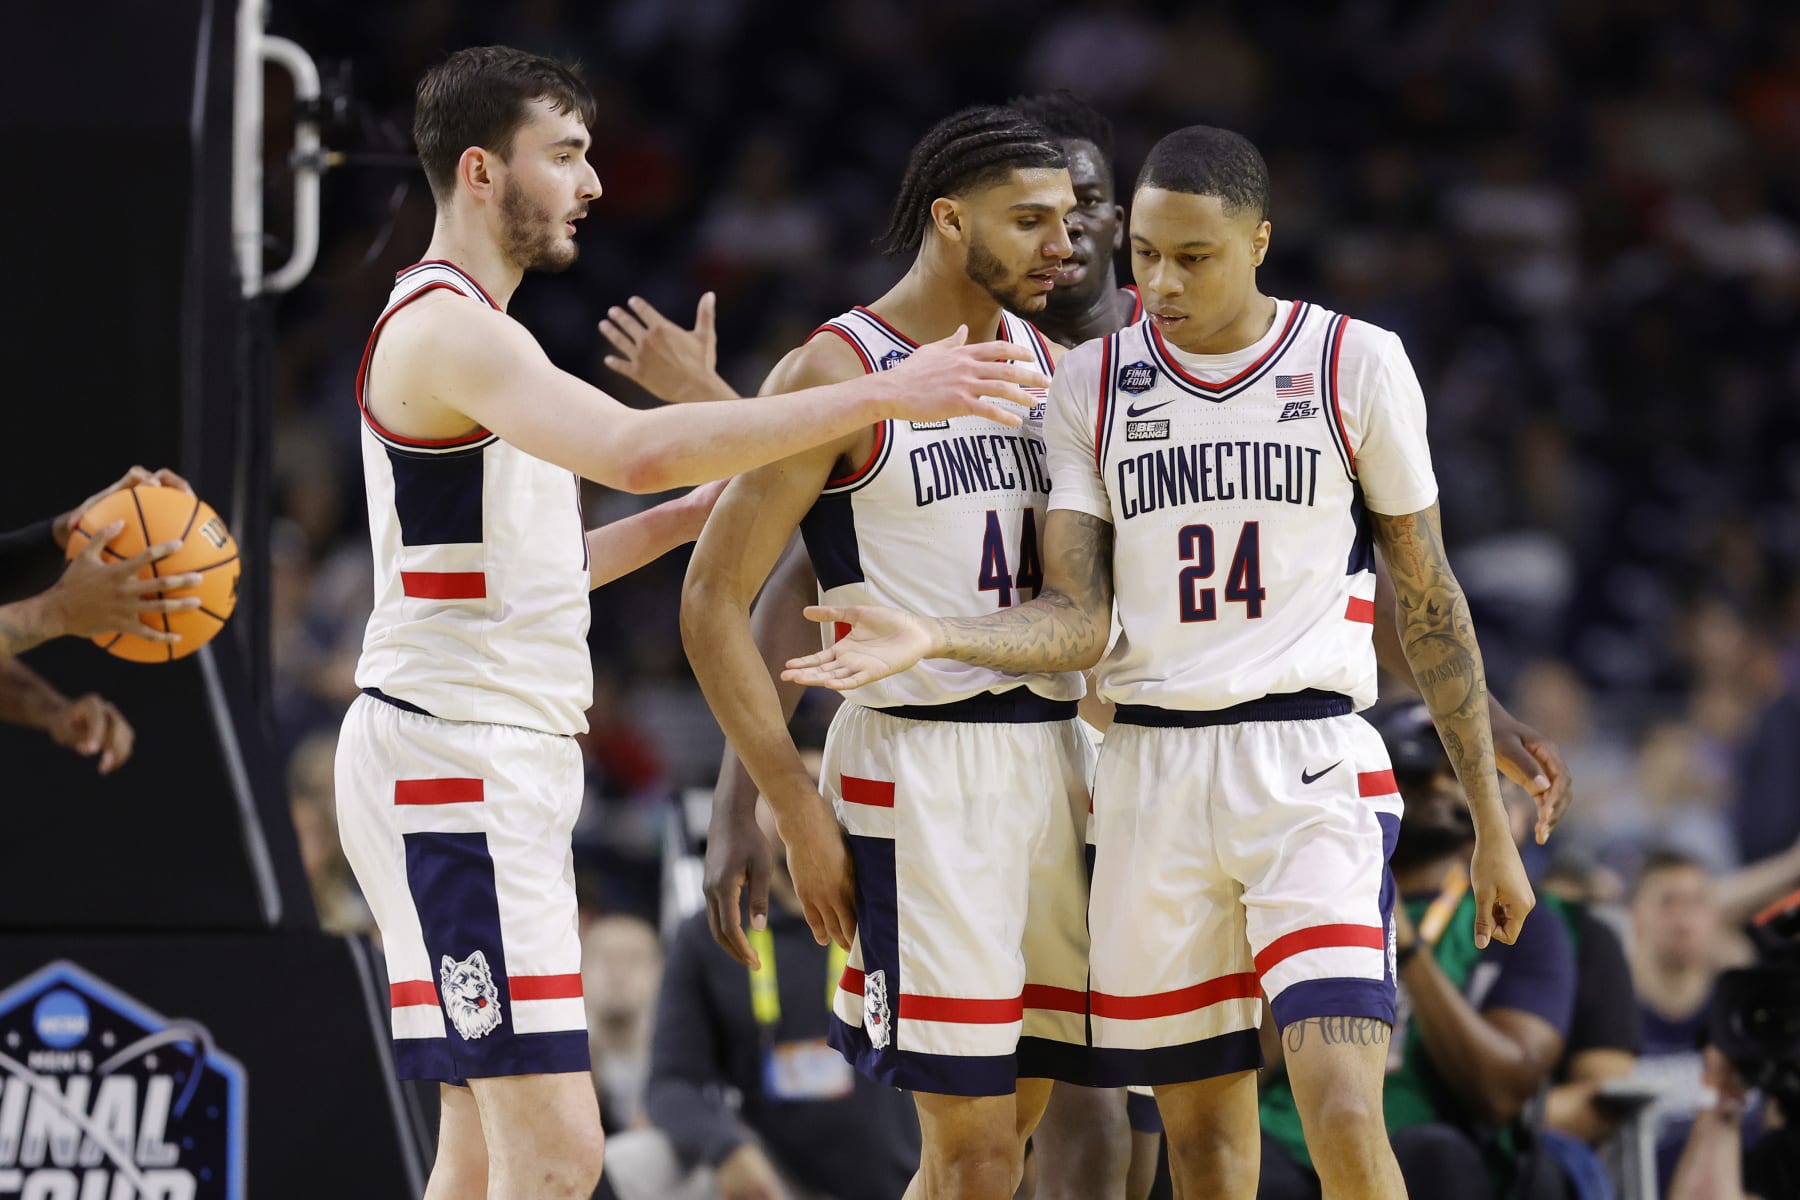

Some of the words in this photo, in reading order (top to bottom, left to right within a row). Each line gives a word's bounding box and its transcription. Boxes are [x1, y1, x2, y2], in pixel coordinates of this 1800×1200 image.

[1126, 369, 1151, 378] FINAL
[1126, 377, 1152, 386] FOUR
[1284, 400, 1311, 410] BIG
[1280, 408, 1320, 418] EAST
[912, 421, 948, 429] CHANGE
[1128, 430, 1168, 440] CHANGE
[909, 435, 1052, 507] CONNECTIC
[1118, 441, 1321, 520] CONNECTICUT
[978, 507, 1043, 608] 44
[1178, 520, 1266, 623] 24
[0, 1074, 180, 1168] INAL
